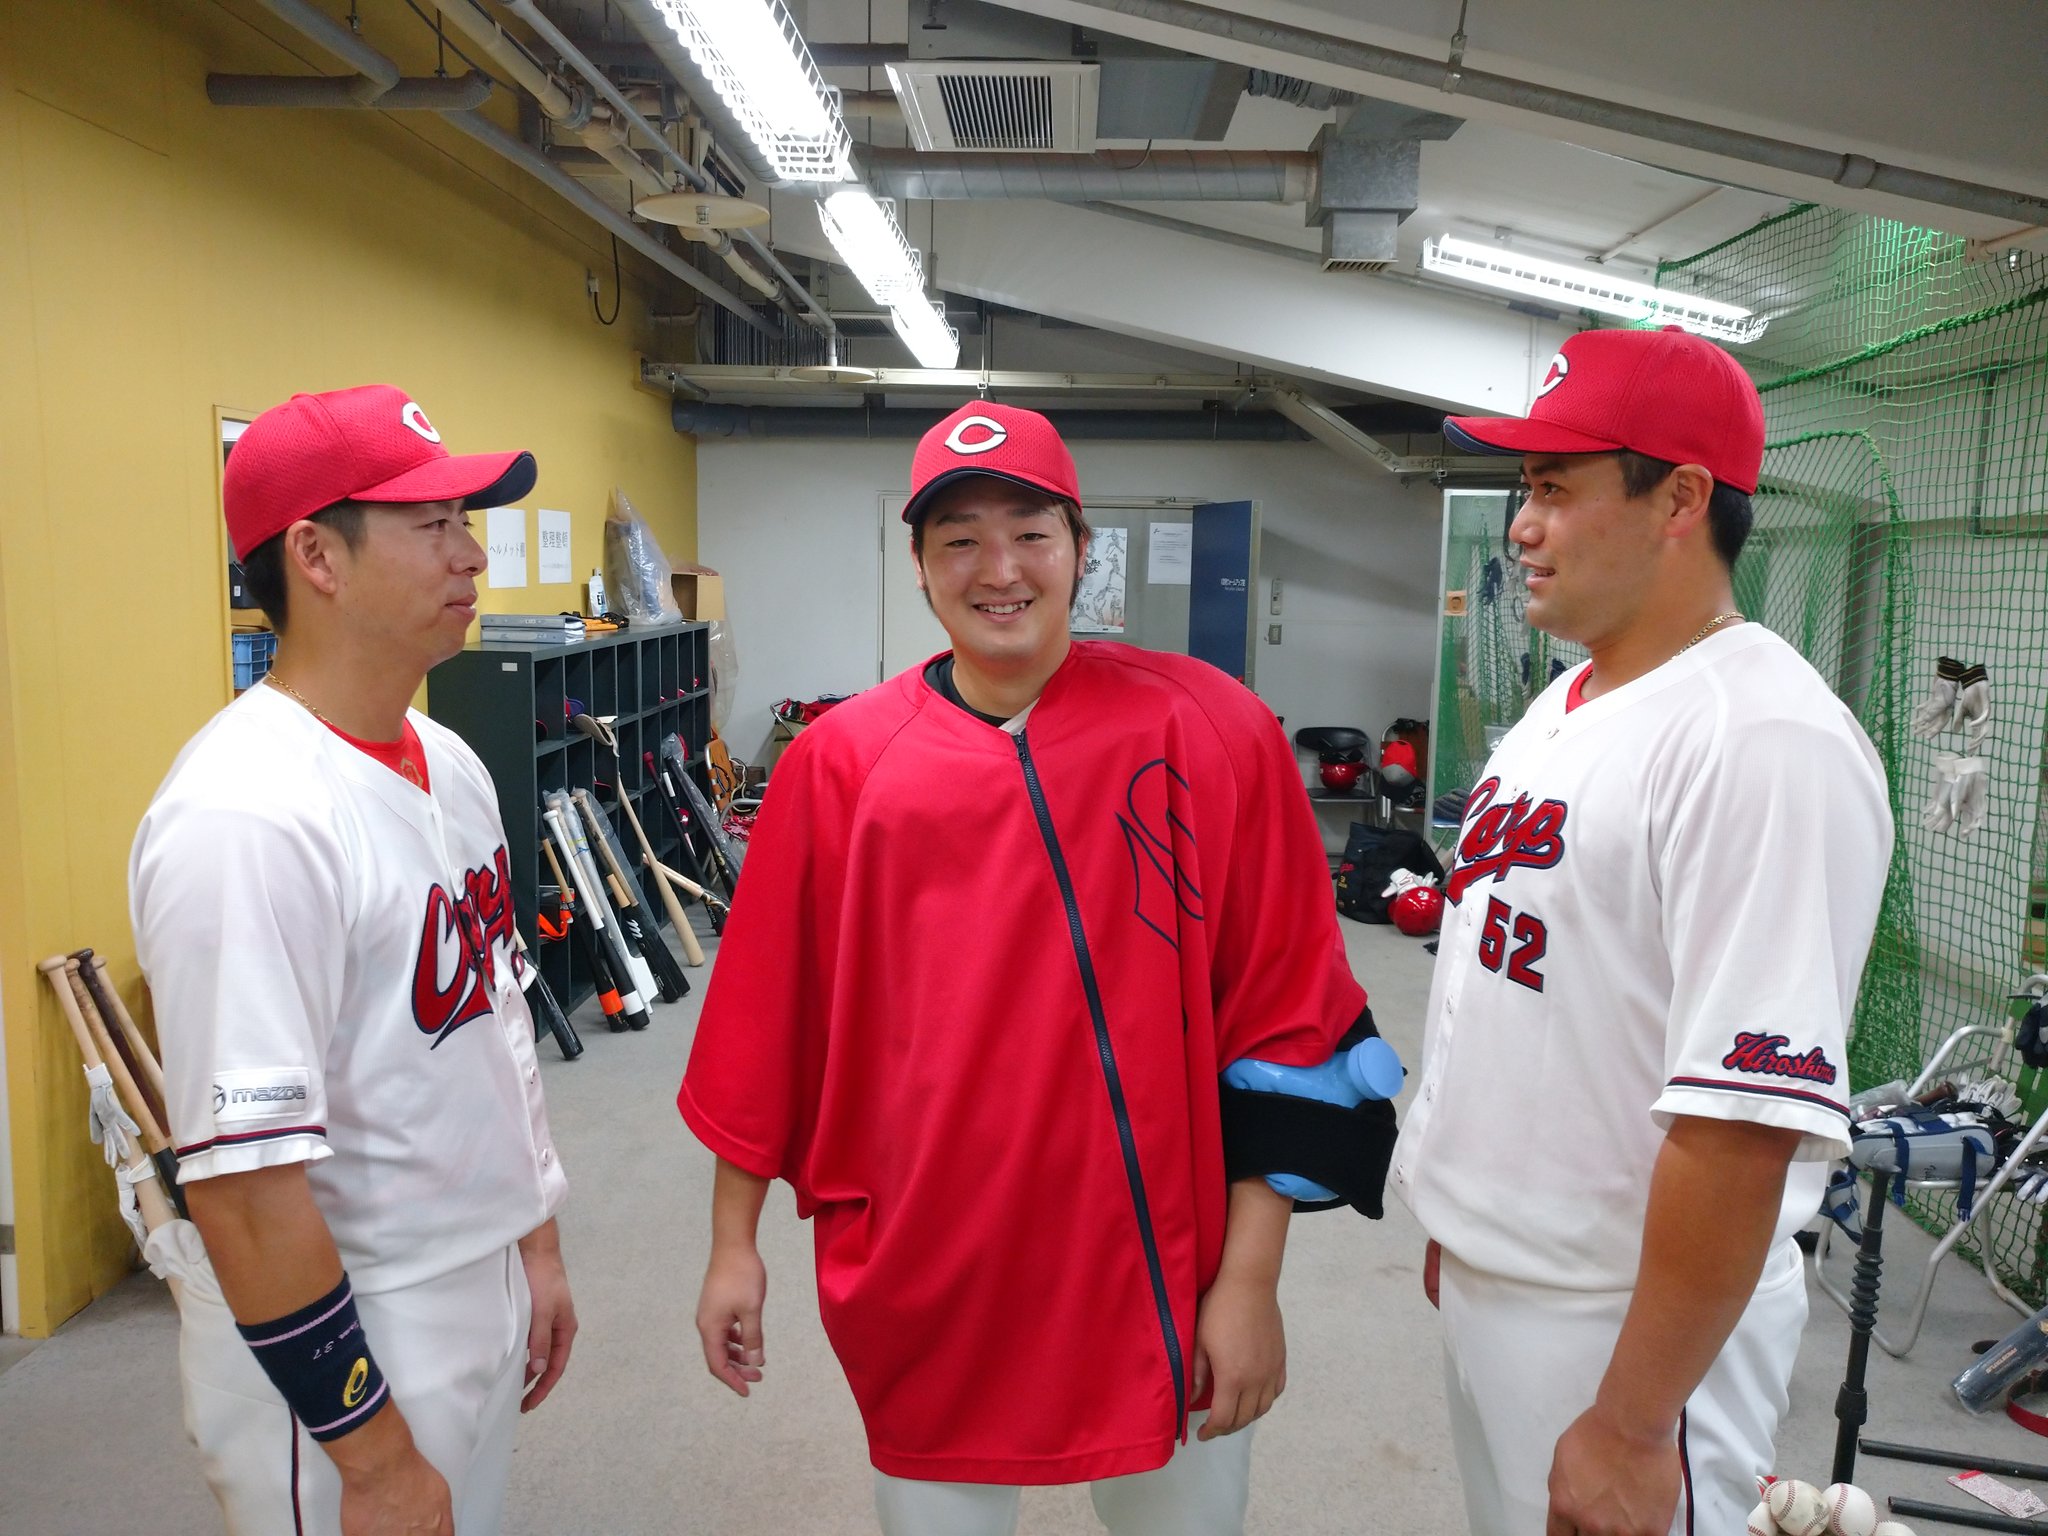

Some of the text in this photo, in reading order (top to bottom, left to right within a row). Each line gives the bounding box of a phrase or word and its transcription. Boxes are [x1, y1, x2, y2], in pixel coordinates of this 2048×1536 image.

[944, 414, 1008, 456] C
[1446, 775, 1568, 908] Carp
[1478, 894, 1547, 993] 52
[1722, 1031, 1836, 1085] Hiroshima
